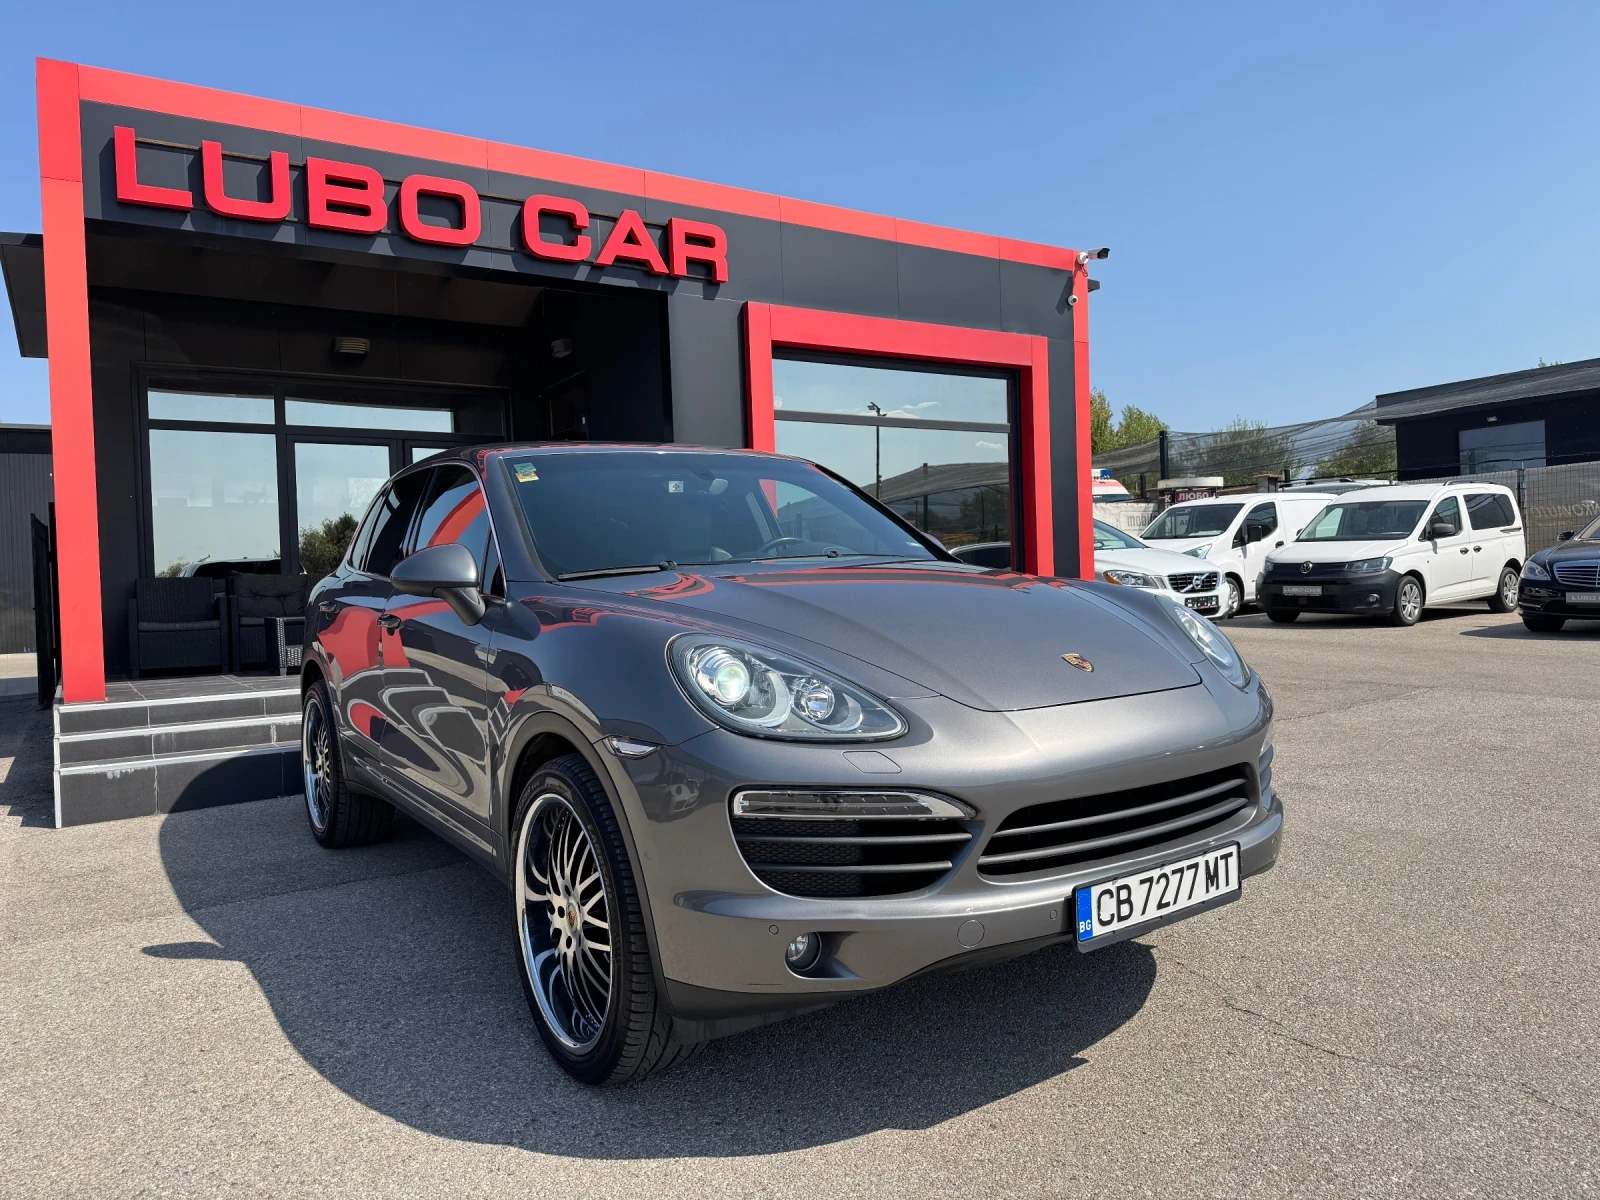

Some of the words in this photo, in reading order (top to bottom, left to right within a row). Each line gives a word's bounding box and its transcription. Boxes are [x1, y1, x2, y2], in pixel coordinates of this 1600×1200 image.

[114, 126, 481, 248] LUBO
[520, 193, 729, 284] CAR
[1178, 491, 1209, 501] ЛЮБО
[1097, 883, 1134, 927] CB
[1139, 862, 1200, 917] 7277
[1204, 851, 1234, 894] MT
[1079, 919, 1092, 933] BG
